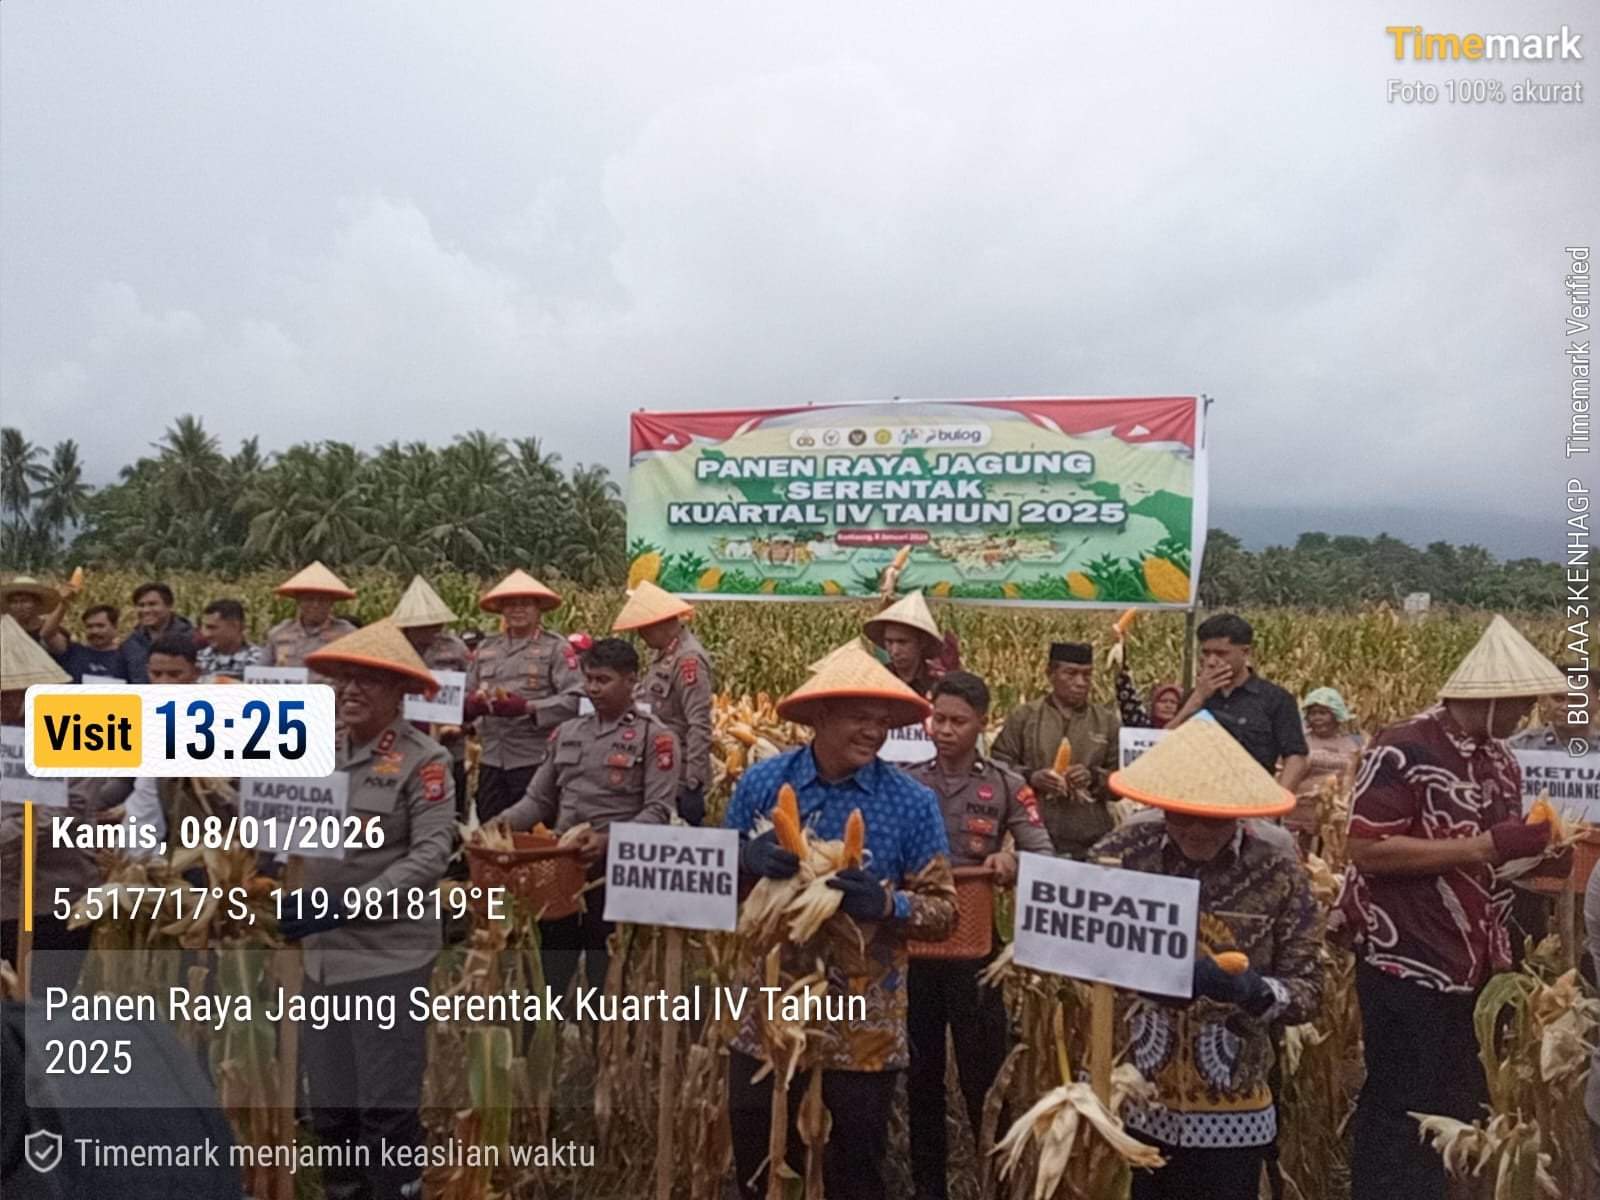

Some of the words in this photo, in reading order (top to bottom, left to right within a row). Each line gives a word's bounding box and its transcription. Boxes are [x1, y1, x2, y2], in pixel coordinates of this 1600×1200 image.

[938, 427, 982, 442] bulog
[697, 456, 819, 480] PANEN
[825, 454, 922, 478] RAYA
[931, 452, 1093, 476] JAGUNG
[785, 477, 984, 501] SERENTAK
[667, 503, 826, 526] KUARTAL
[834, 503, 872, 525] IV
[880, 502, 1010, 525] TAHUN
[1018, 501, 1127, 525] 2025
[252, 781, 334, 805] KAPOLDA
[618, 842, 725, 868] BUPATI
[612, 864, 733, 896] BANTAENG
[1031, 880, 1180, 926] BUPATI
[1021, 905, 1189, 960] JENEPONTO
